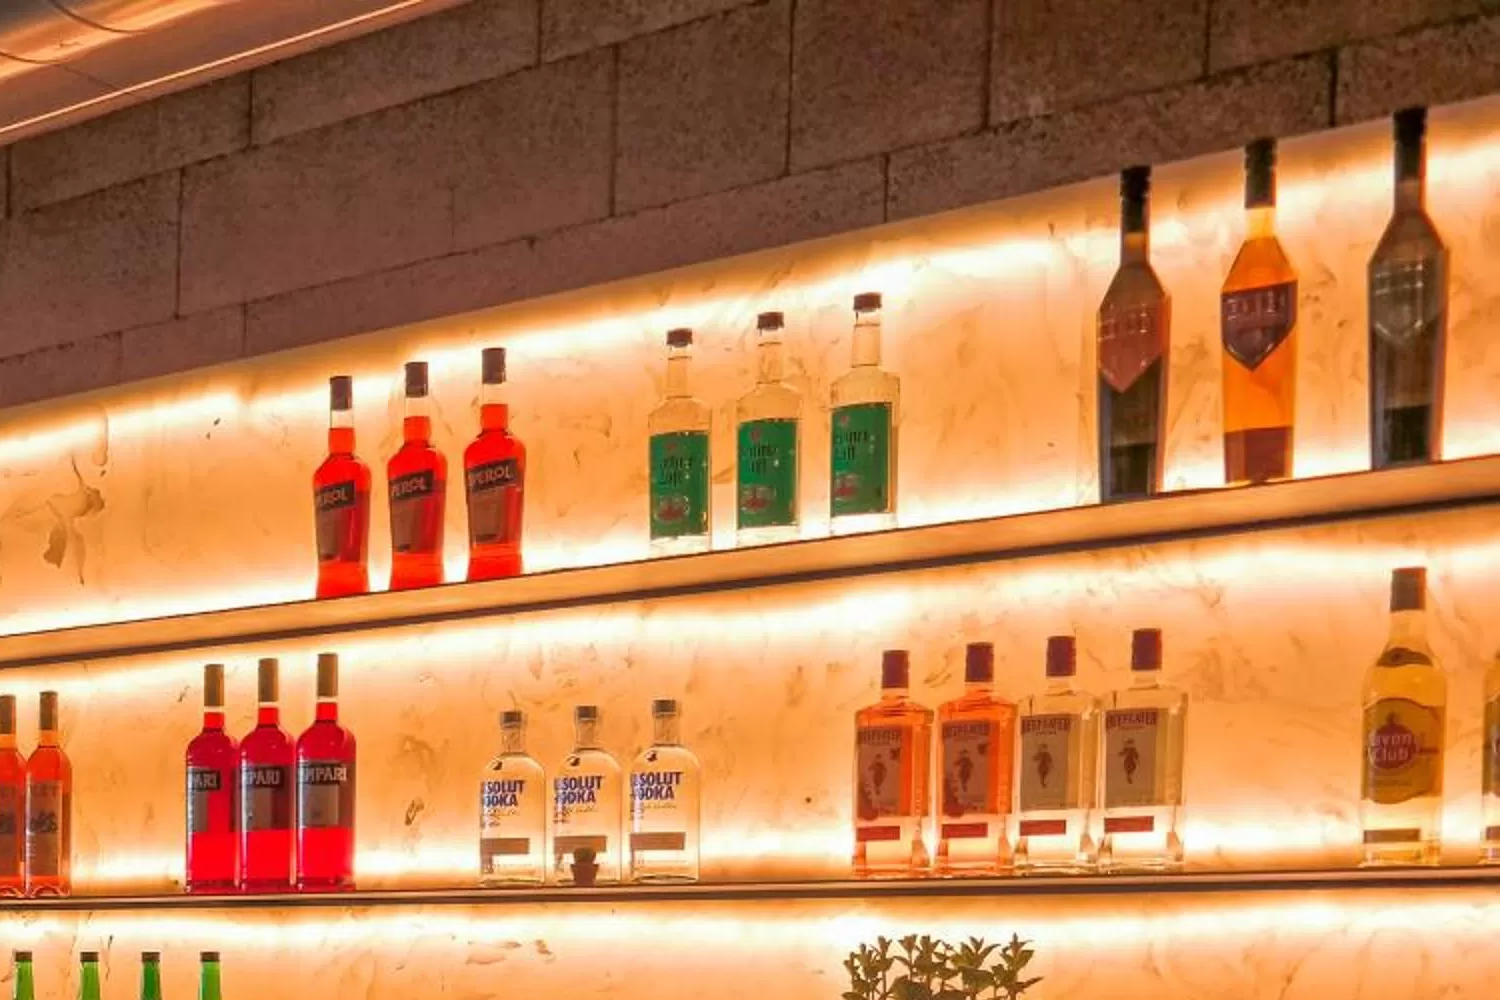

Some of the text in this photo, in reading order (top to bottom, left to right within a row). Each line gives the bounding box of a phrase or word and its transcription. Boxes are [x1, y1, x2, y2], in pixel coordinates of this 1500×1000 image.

[485, 779, 526, 795] SOLUT
[558, 775, 605, 791] SOLUT
[634, 771, 684, 787] SOLUT
